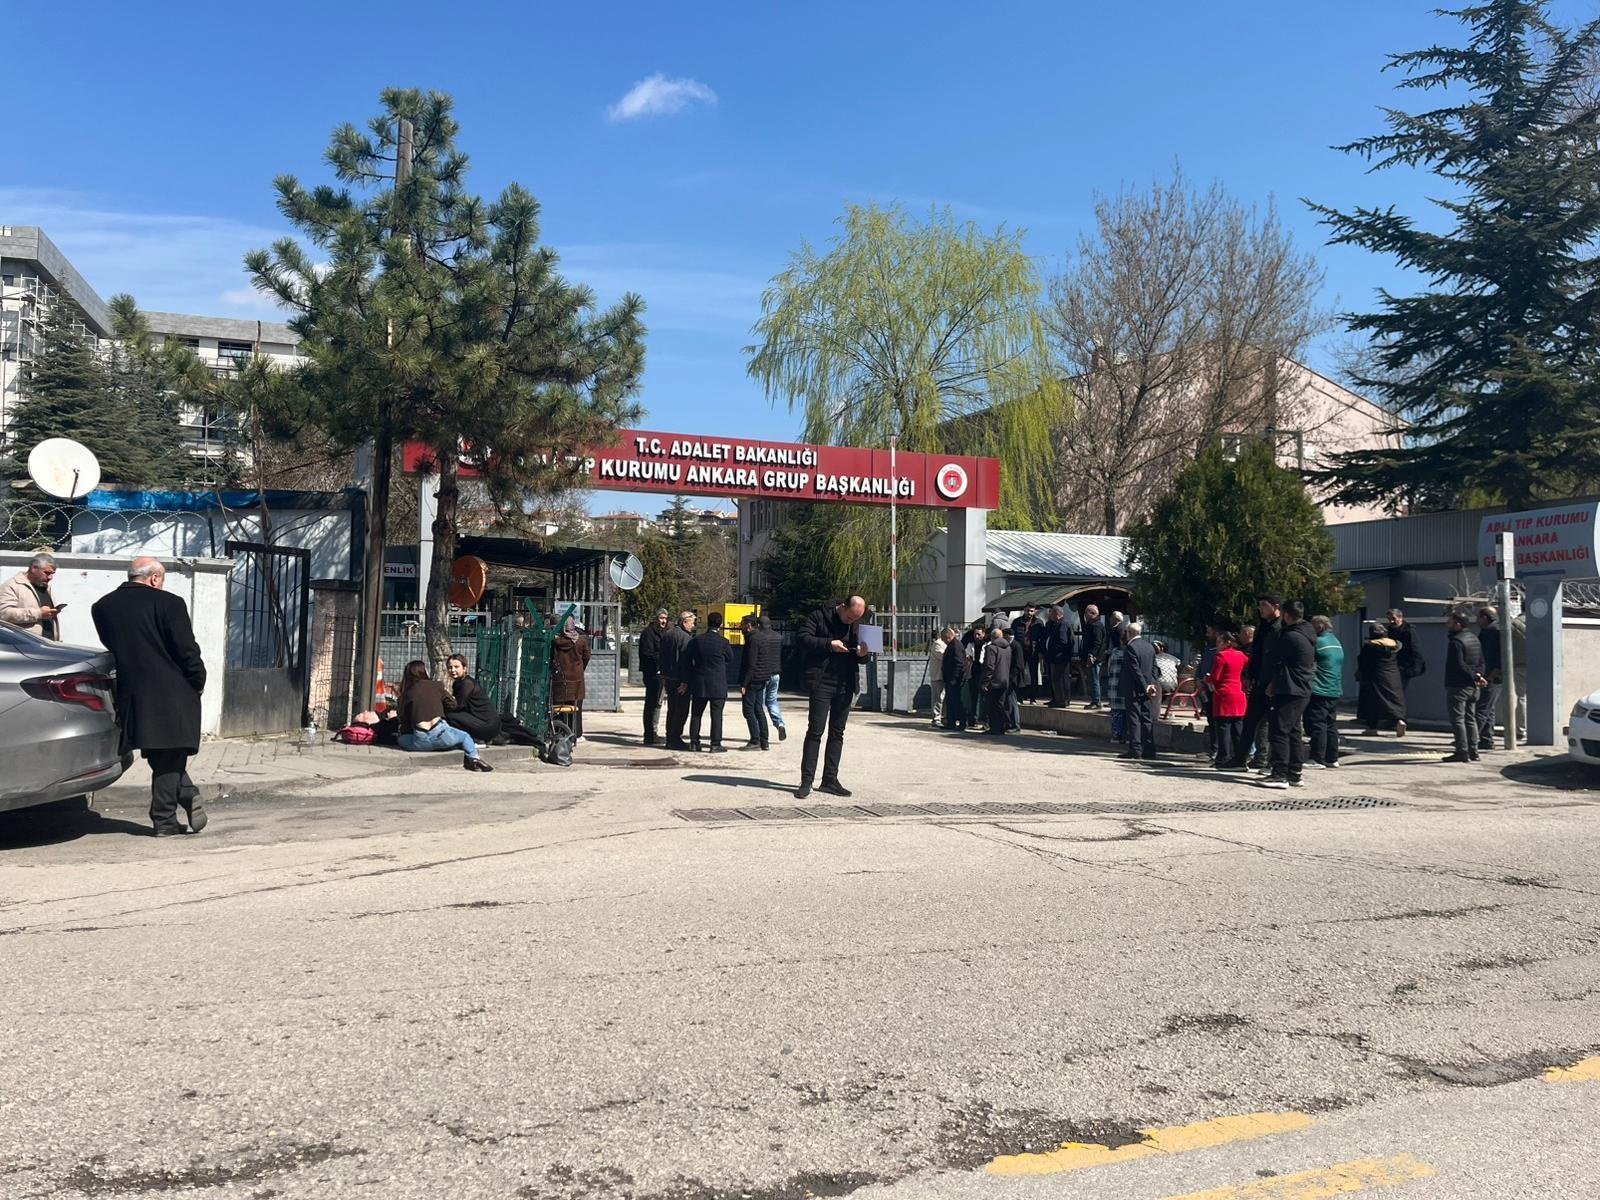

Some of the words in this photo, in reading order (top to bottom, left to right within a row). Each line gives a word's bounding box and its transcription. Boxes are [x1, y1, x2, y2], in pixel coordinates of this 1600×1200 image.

[636, 437, 666, 455] T.C.
[670, 440, 731, 460] ADALET
[735, 445, 817, 466] BAKANLIĞI
[601, 459, 681, 481] KURUMU
[686, 465, 758, 487] ANKARA
[764, 470, 809, 489] GRUP
[816, 473, 915, 496] BAŞKANLIĞI
[1536, 511, 1589, 527] KURUMU
